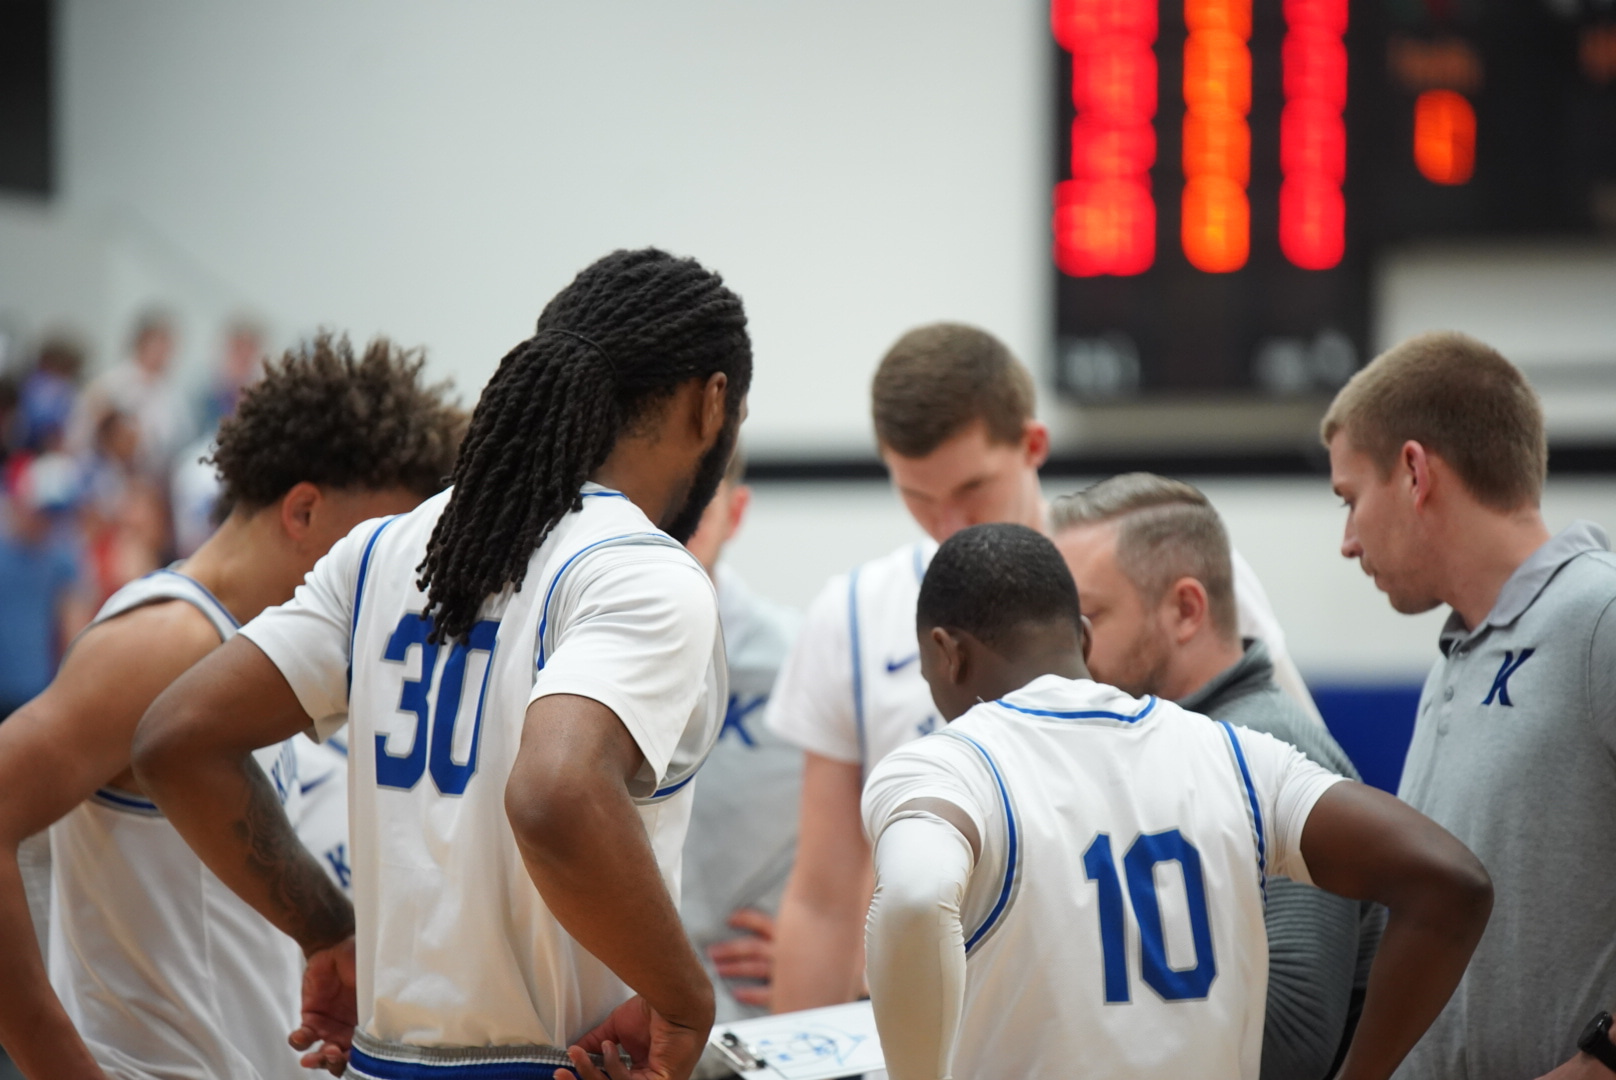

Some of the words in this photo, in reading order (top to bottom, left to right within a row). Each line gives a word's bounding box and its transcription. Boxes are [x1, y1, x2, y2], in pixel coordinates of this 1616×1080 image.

[374, 609, 502, 798] 30
[718, 692, 770, 750] K
[1481, 647, 1536, 707] K
[1080, 826, 1219, 1006] 10
